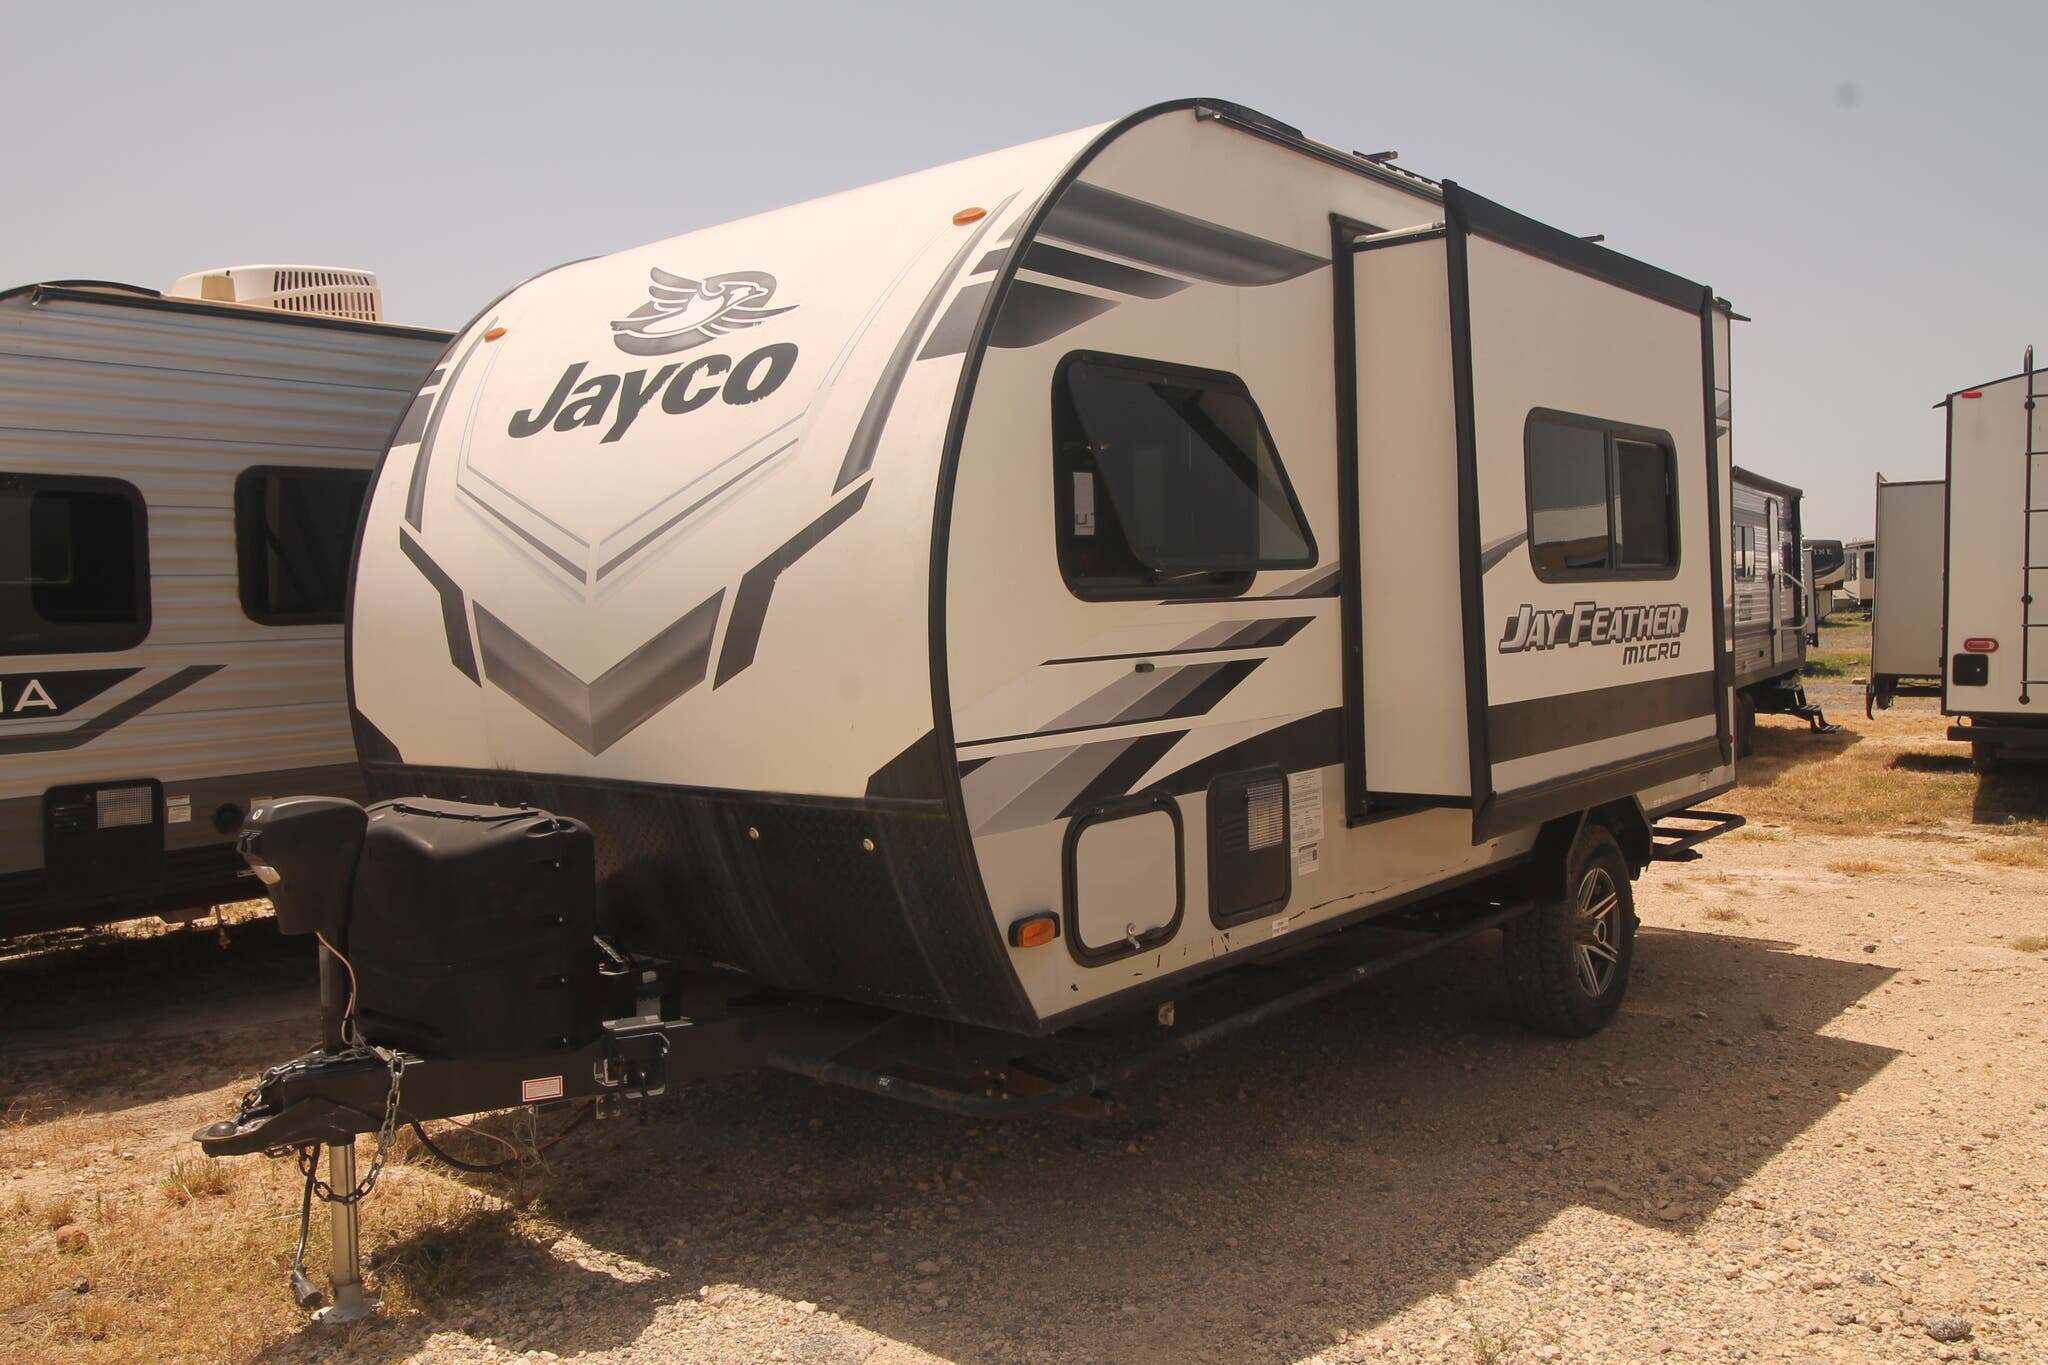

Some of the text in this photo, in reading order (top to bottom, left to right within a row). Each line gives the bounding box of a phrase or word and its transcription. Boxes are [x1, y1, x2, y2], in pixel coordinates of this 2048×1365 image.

[508, 342, 799, 445] Jayco
[1498, 601, 1683, 654] JAY FEATHER
[1623, 641, 1681, 665] MICRO
